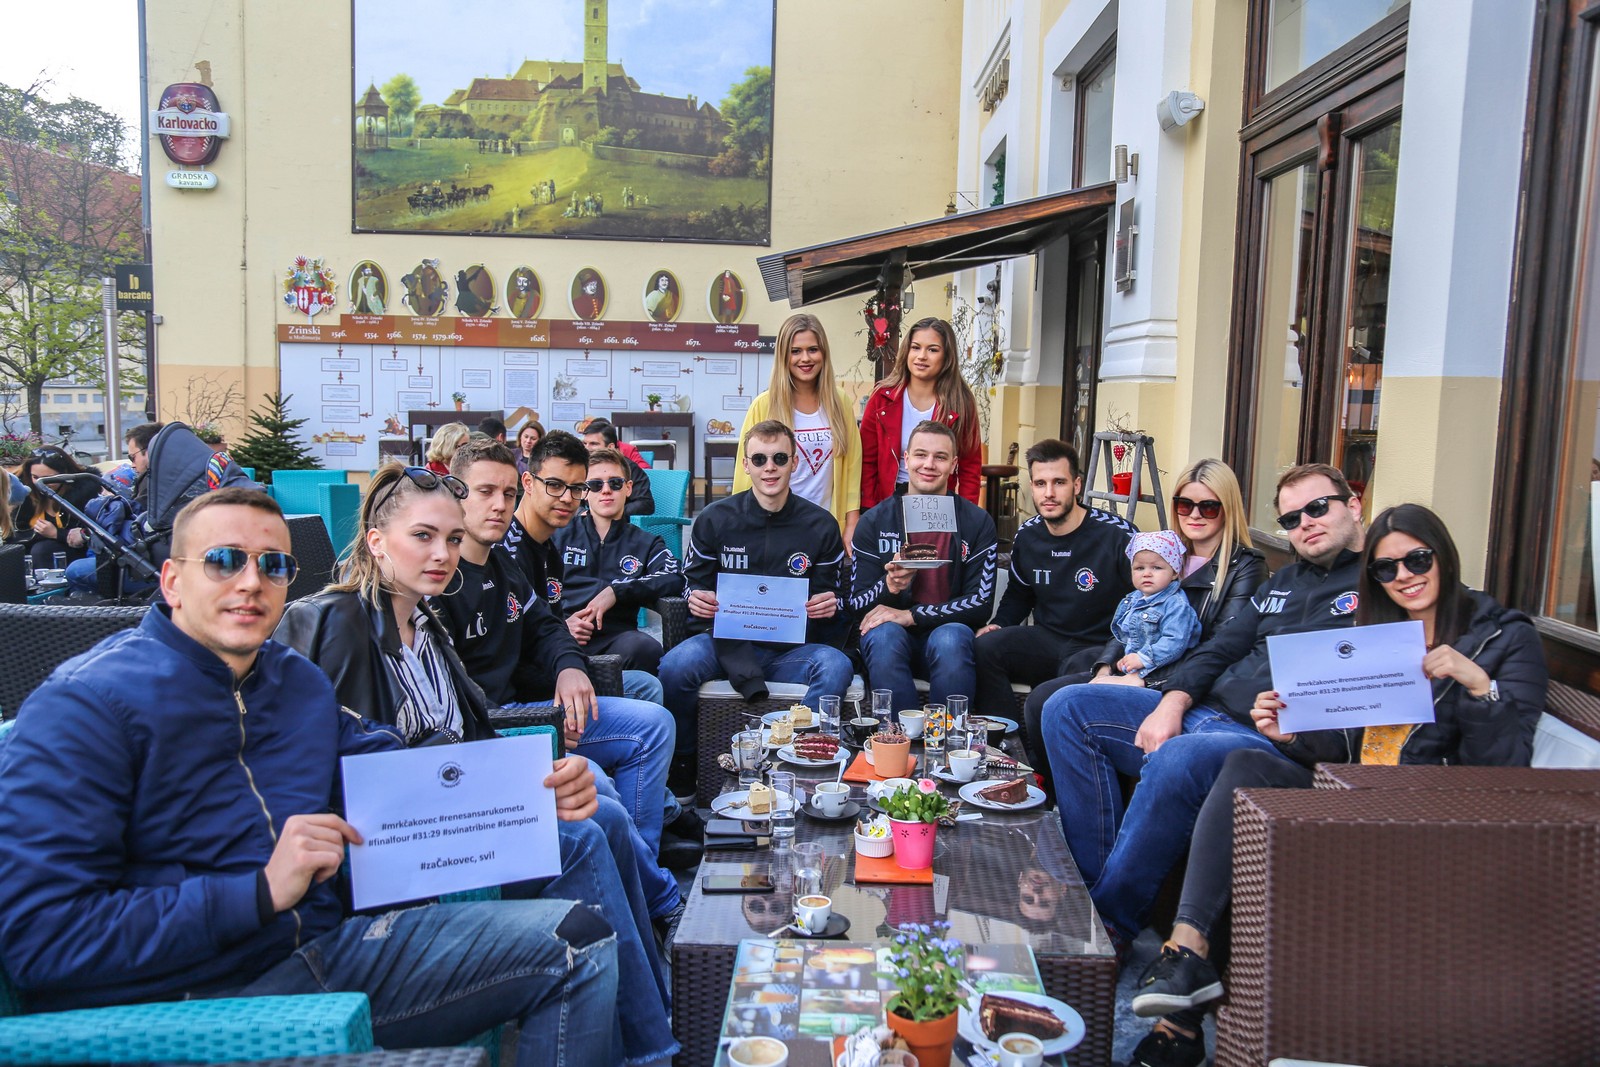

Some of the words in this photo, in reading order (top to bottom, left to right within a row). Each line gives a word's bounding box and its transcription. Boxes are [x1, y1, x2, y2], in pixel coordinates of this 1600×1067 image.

[158, 116, 217, 130] Karlovačko
[171, 172, 209, 180] GRADSKA
[288, 326, 320, 334] Zrinski
[332, 330, 347, 338] 1546.
[387, 331, 402, 340] 1566.
[432, 333, 448, 341] 1579.
[448, 333, 463, 341] 1603.
[622, 337, 639, 345] 1664.
[734, 340, 749, 348] 1673.
[797, 432, 832, 442] GUES
[921, 512, 948, 520] BRAVO
[878, 539, 901, 553] DH
[564, 552, 586, 566] EH
[721, 553, 748, 569] MH
[1033, 569, 1051, 584] TT
[466, 612, 487, 639] LČ
[1297, 679, 1337, 687] #mrkčakovec
[1339, 672, 1404, 683] #renesansarukometa
[1342, 683, 1382, 692] #svinatribine
[1383, 680, 1416, 688] #šampioni
[1325, 704, 1367, 713] #zaČakovec,
[382, 817, 438, 830] #mrkčakovec
[439, 805, 524, 822] #renesansarukometa
[368, 835, 410, 847] #finalfour
[412, 830, 441, 840] #31:29
[443, 822, 496, 836] #svinatribine
[498, 815, 539, 828] #šampioni
[421, 856, 477, 870] #zaČakovec,
[480, 850, 495, 861] svi!
